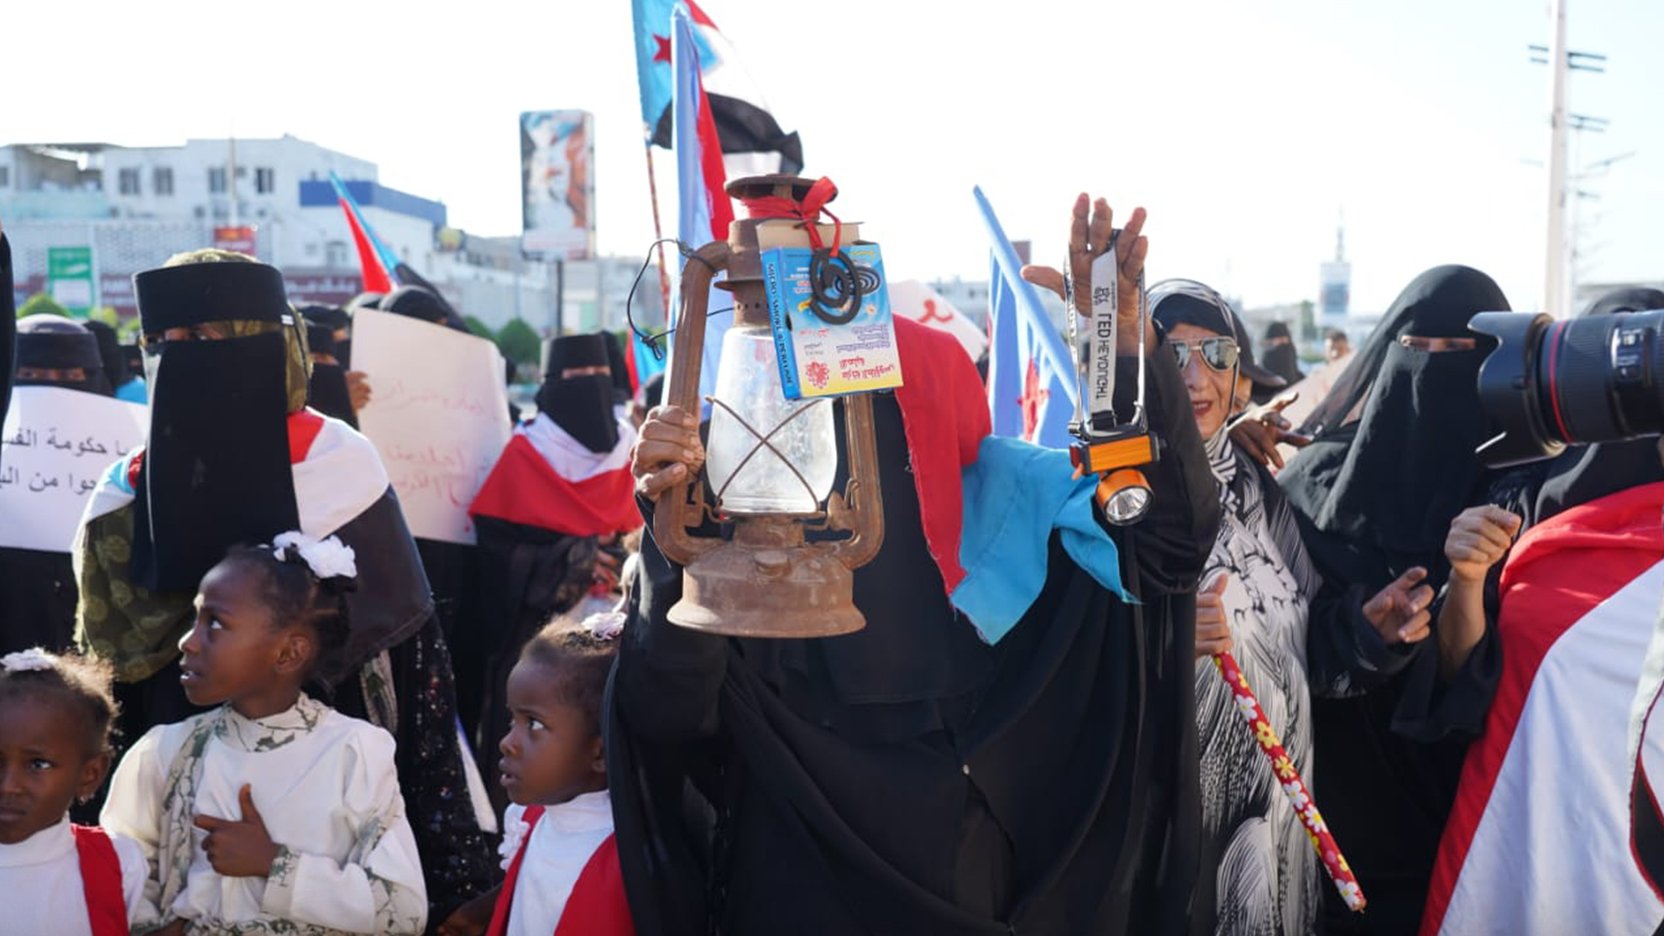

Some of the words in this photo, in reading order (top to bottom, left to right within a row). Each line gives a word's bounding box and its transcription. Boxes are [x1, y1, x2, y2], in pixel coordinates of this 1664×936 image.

[46, 427, 108, 458] حكومة
[28, 471, 59, 492] من
[68, 472, 97, 495] حوا
